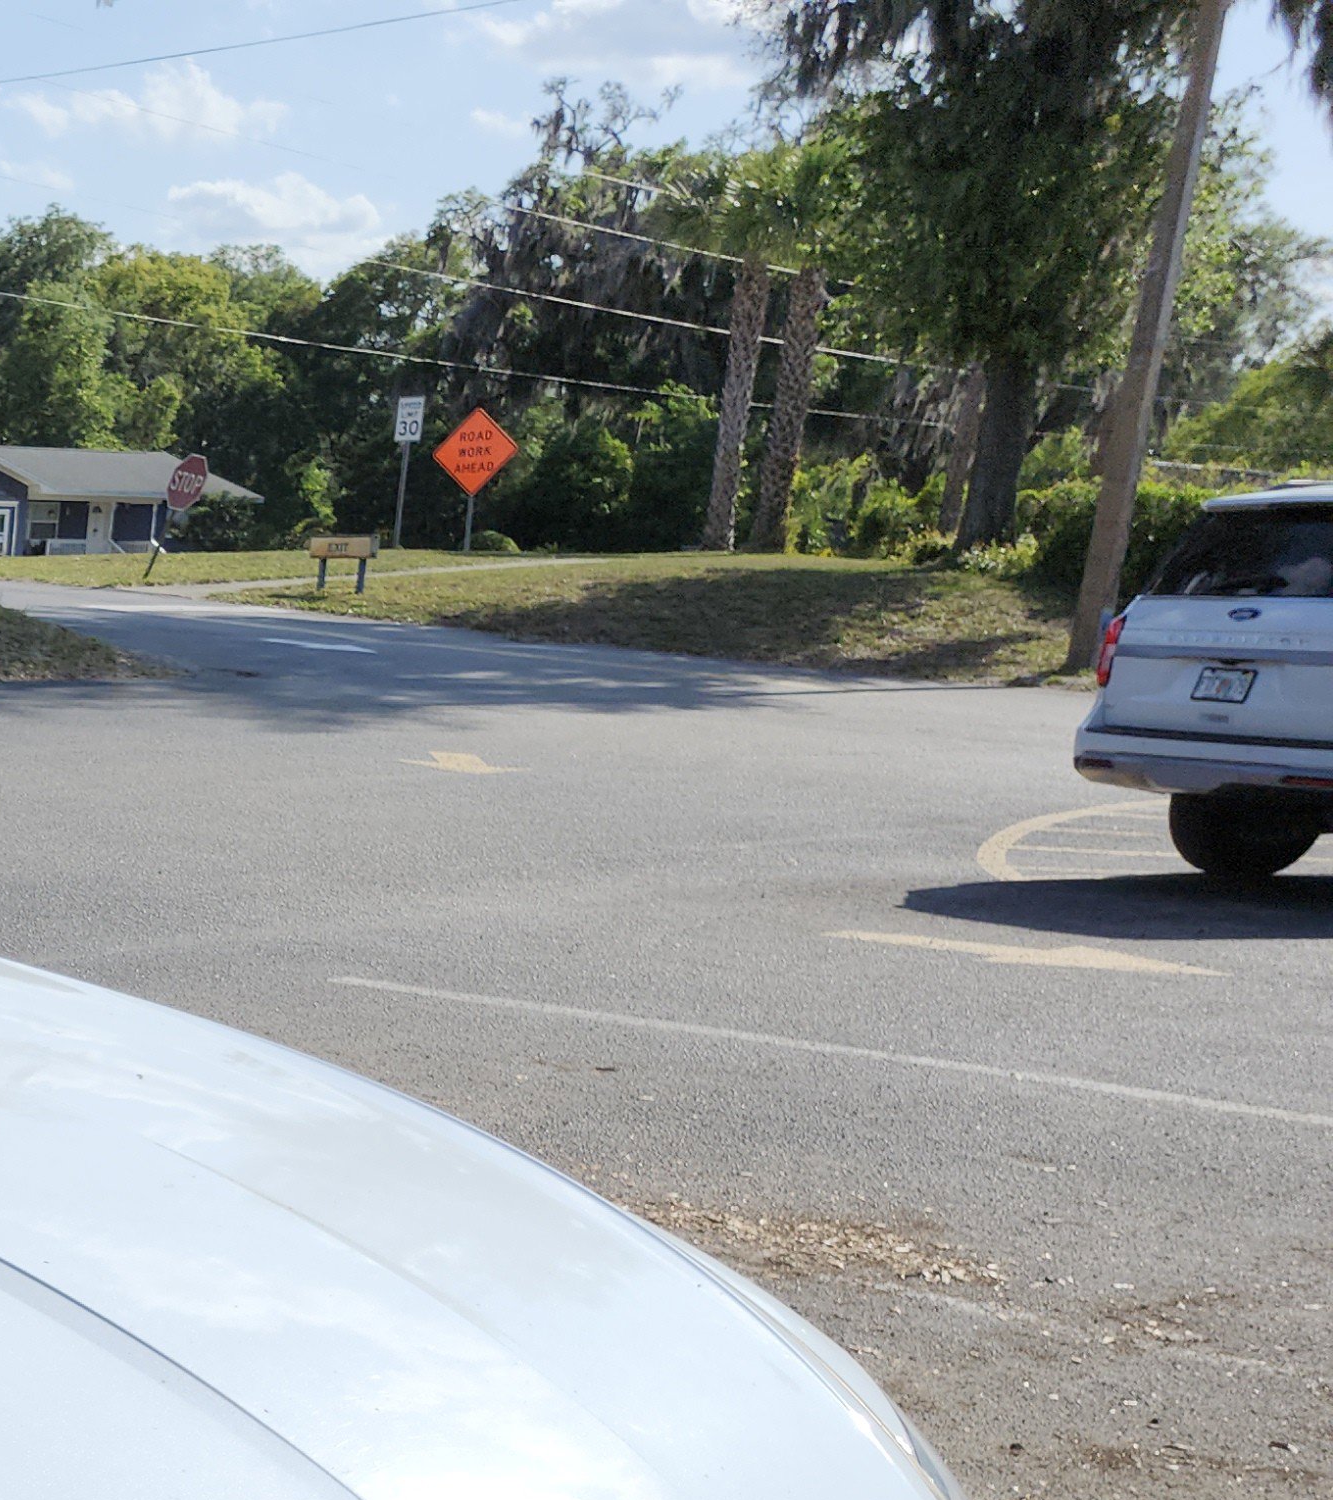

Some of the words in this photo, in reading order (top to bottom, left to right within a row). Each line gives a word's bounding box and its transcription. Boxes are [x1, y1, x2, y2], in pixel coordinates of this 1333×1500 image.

[398, 420, 419, 436] 30
[459, 430, 492, 441] ROAD
[458, 446, 492, 457] WORK
[454, 462, 494, 473] AHEAD
[170, 470, 204, 494] STOP
[327, 543, 349, 552] EXIT
